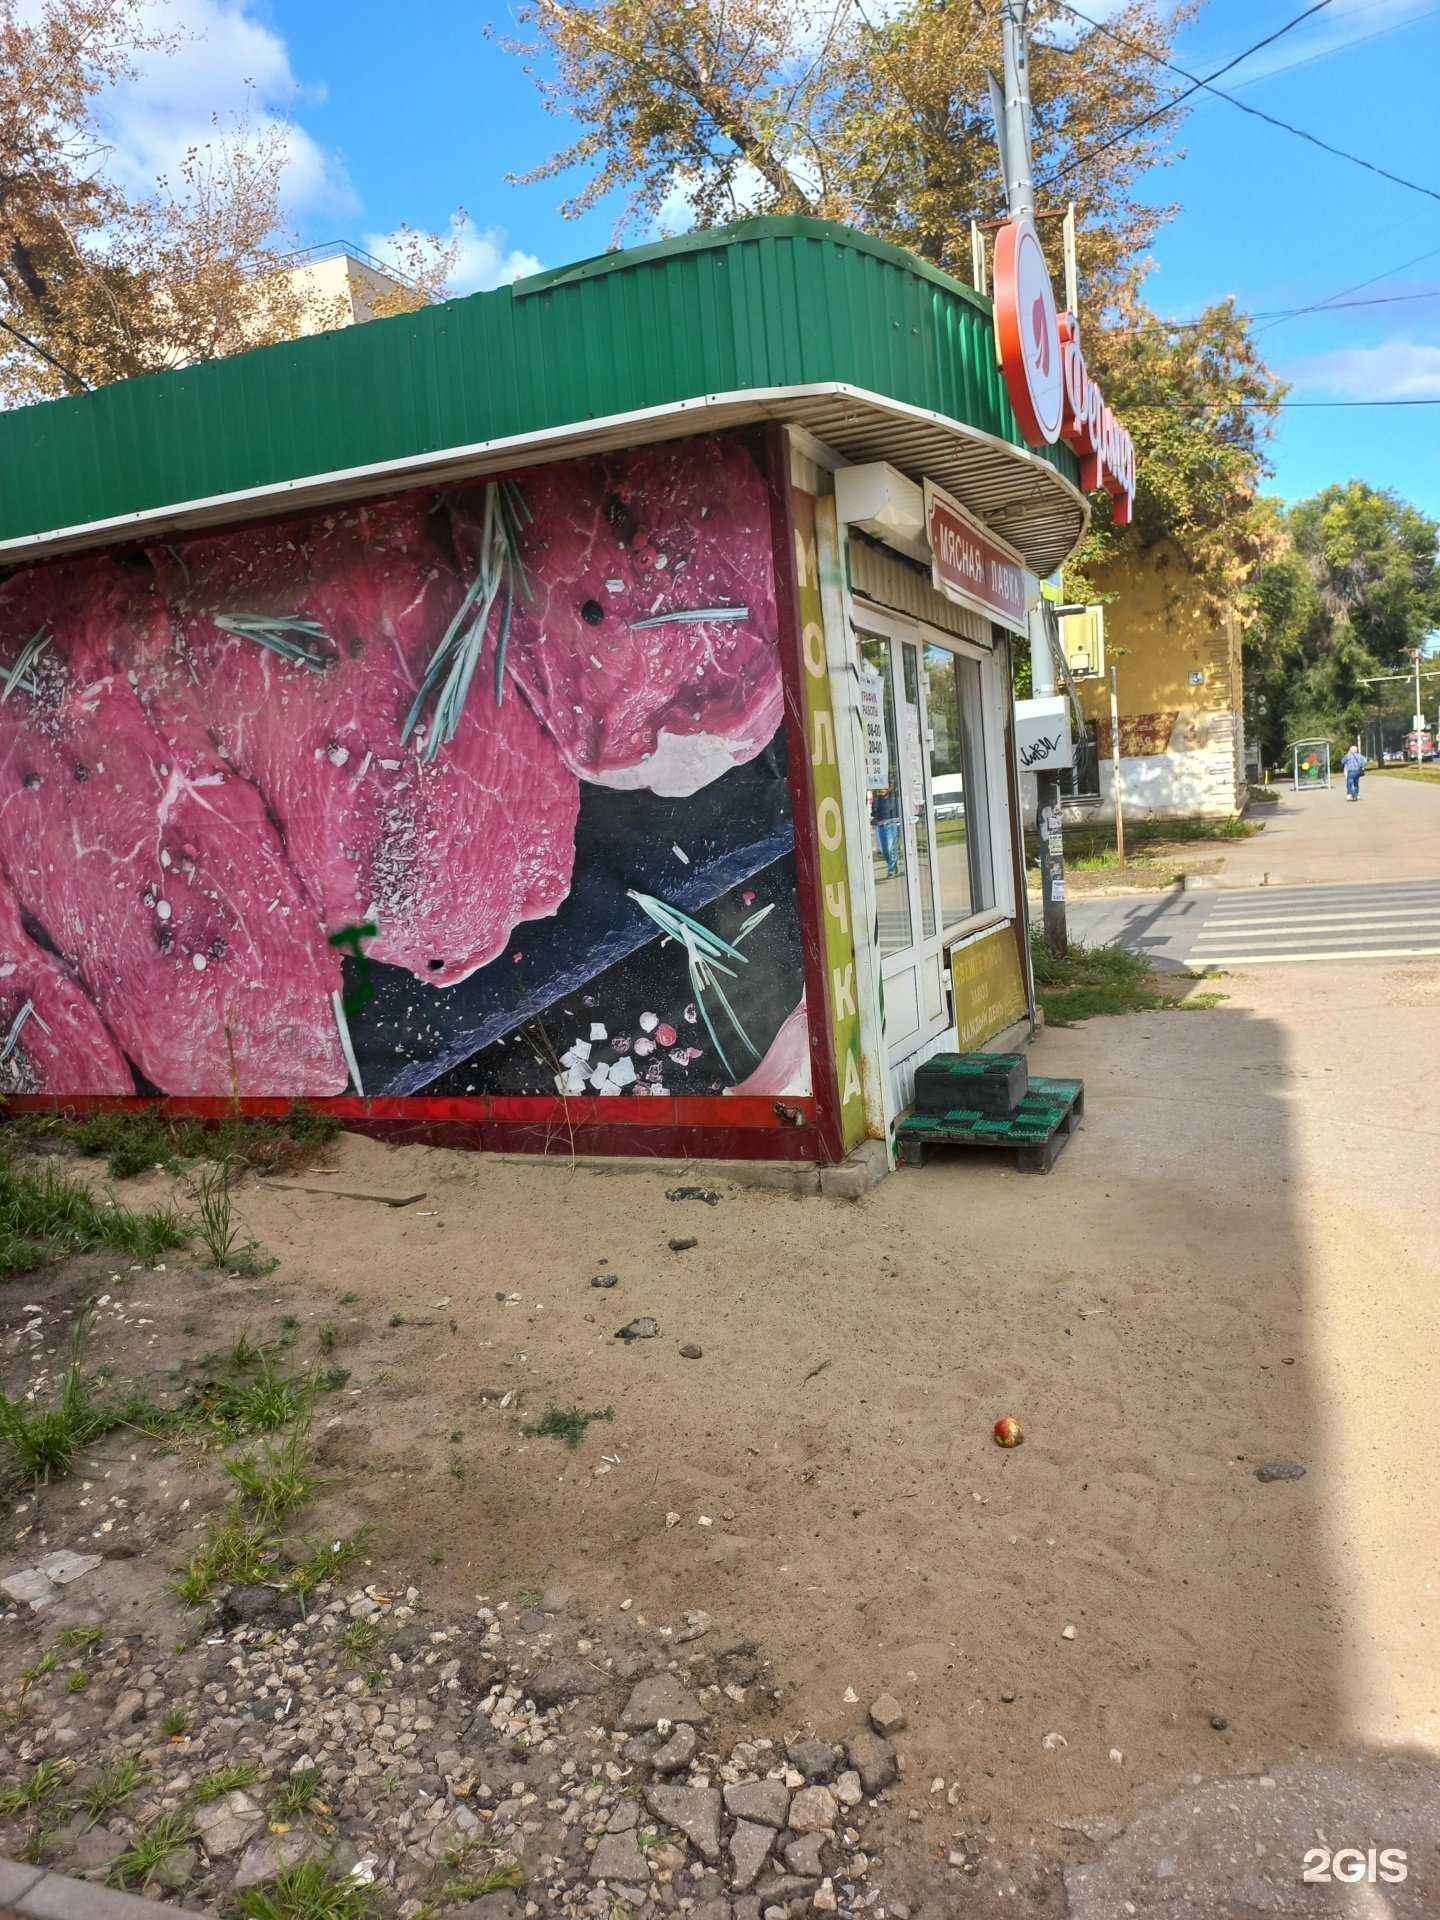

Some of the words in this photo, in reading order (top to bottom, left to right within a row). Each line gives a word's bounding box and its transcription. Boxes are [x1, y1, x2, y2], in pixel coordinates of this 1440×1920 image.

[940, 523, 985, 583] МЯСНАЯ
[991, 560, 1021, 607] ЛАВКА
[794, 528, 862, 1105] МОЛОЧКА
